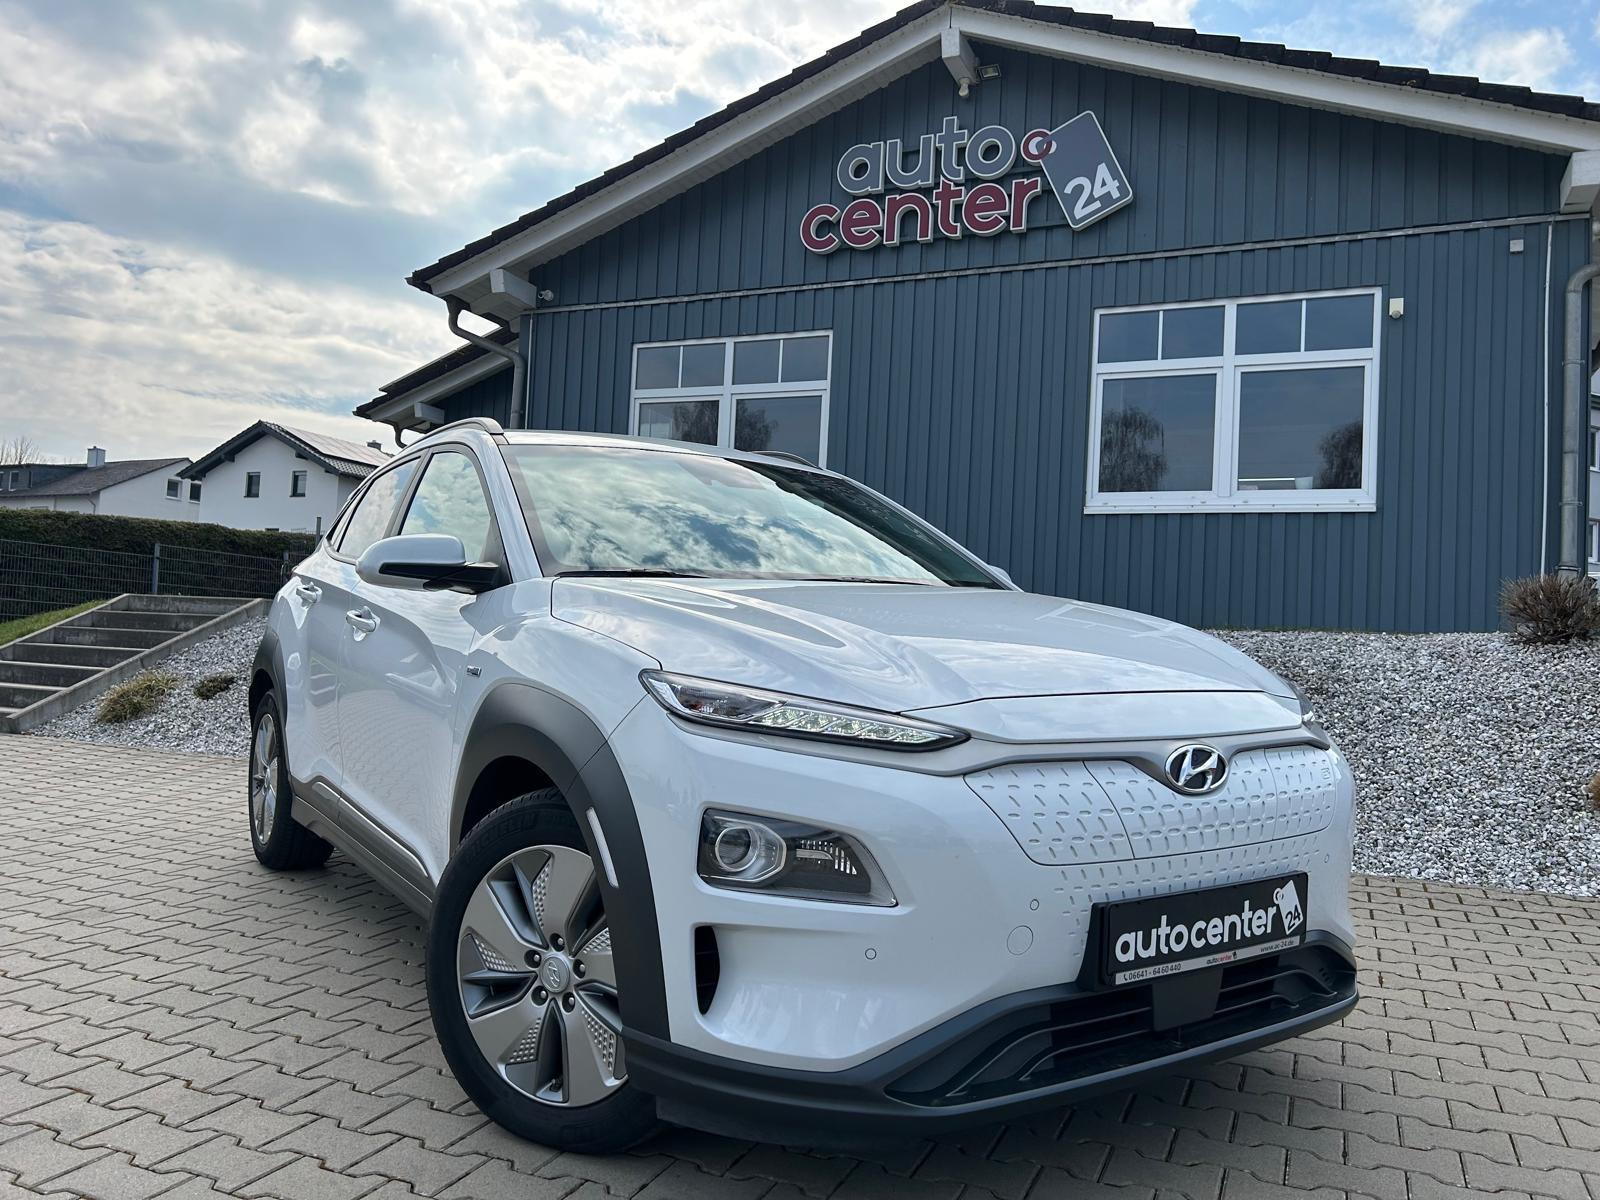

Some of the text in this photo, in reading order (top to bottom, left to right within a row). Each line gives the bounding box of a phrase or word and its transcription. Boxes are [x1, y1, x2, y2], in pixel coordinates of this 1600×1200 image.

[837, 116, 1016, 194] auto
[800, 163, 1119, 252] center 24
[1115, 901, 1301, 962] autocenter 24
[1129, 970, 1147, 980] 06641
